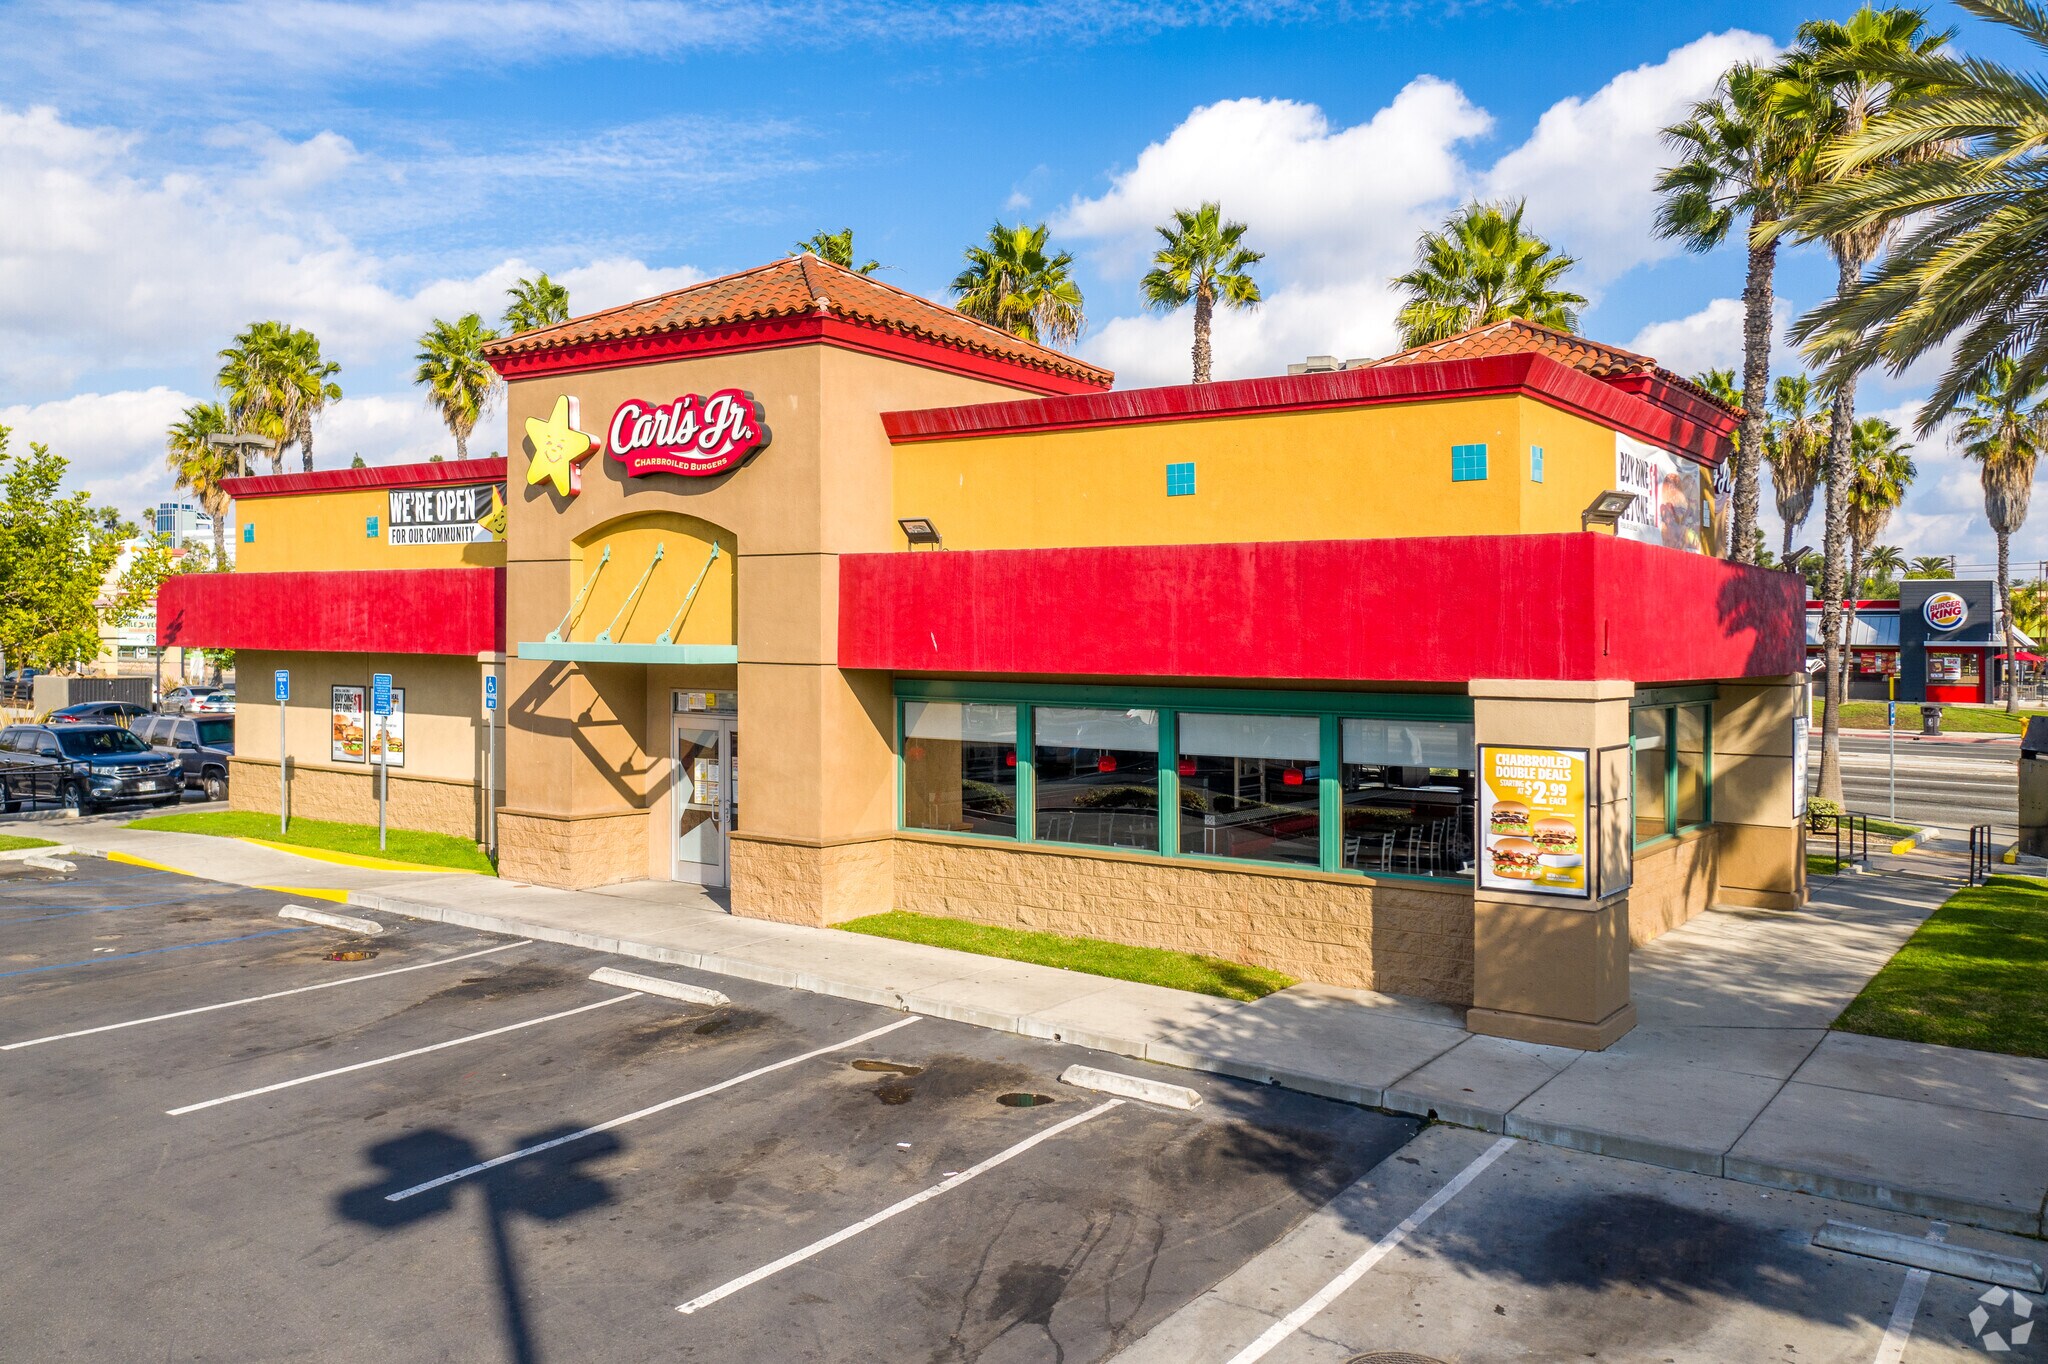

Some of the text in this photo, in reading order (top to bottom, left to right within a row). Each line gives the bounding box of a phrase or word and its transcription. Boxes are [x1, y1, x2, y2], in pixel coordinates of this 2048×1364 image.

[611, 395, 753, 454] Carl's Jr.
[634, 457, 728, 471] CHARBROILED BURGERS
[1620, 452, 1635, 485] BUY
[389, 488, 476, 523] WE'RE OPEN
[391, 526, 475, 544] FOR OUR COMMUNITY
[1930, 600, 1961, 612] BURGER
[1931, 606, 1961, 621] KING
[335, 693, 353, 703] BUY ONE
[1496, 754, 1572, 768] CHARBROILED
[1495, 766, 1572, 782] DOUBLE DEALS
[1499, 779, 1525, 788] STARTING
[1517, 787, 1524, 795] AT
[1524, 780, 1567, 804] $2.99
[1549, 797, 1567, 806] EACH
